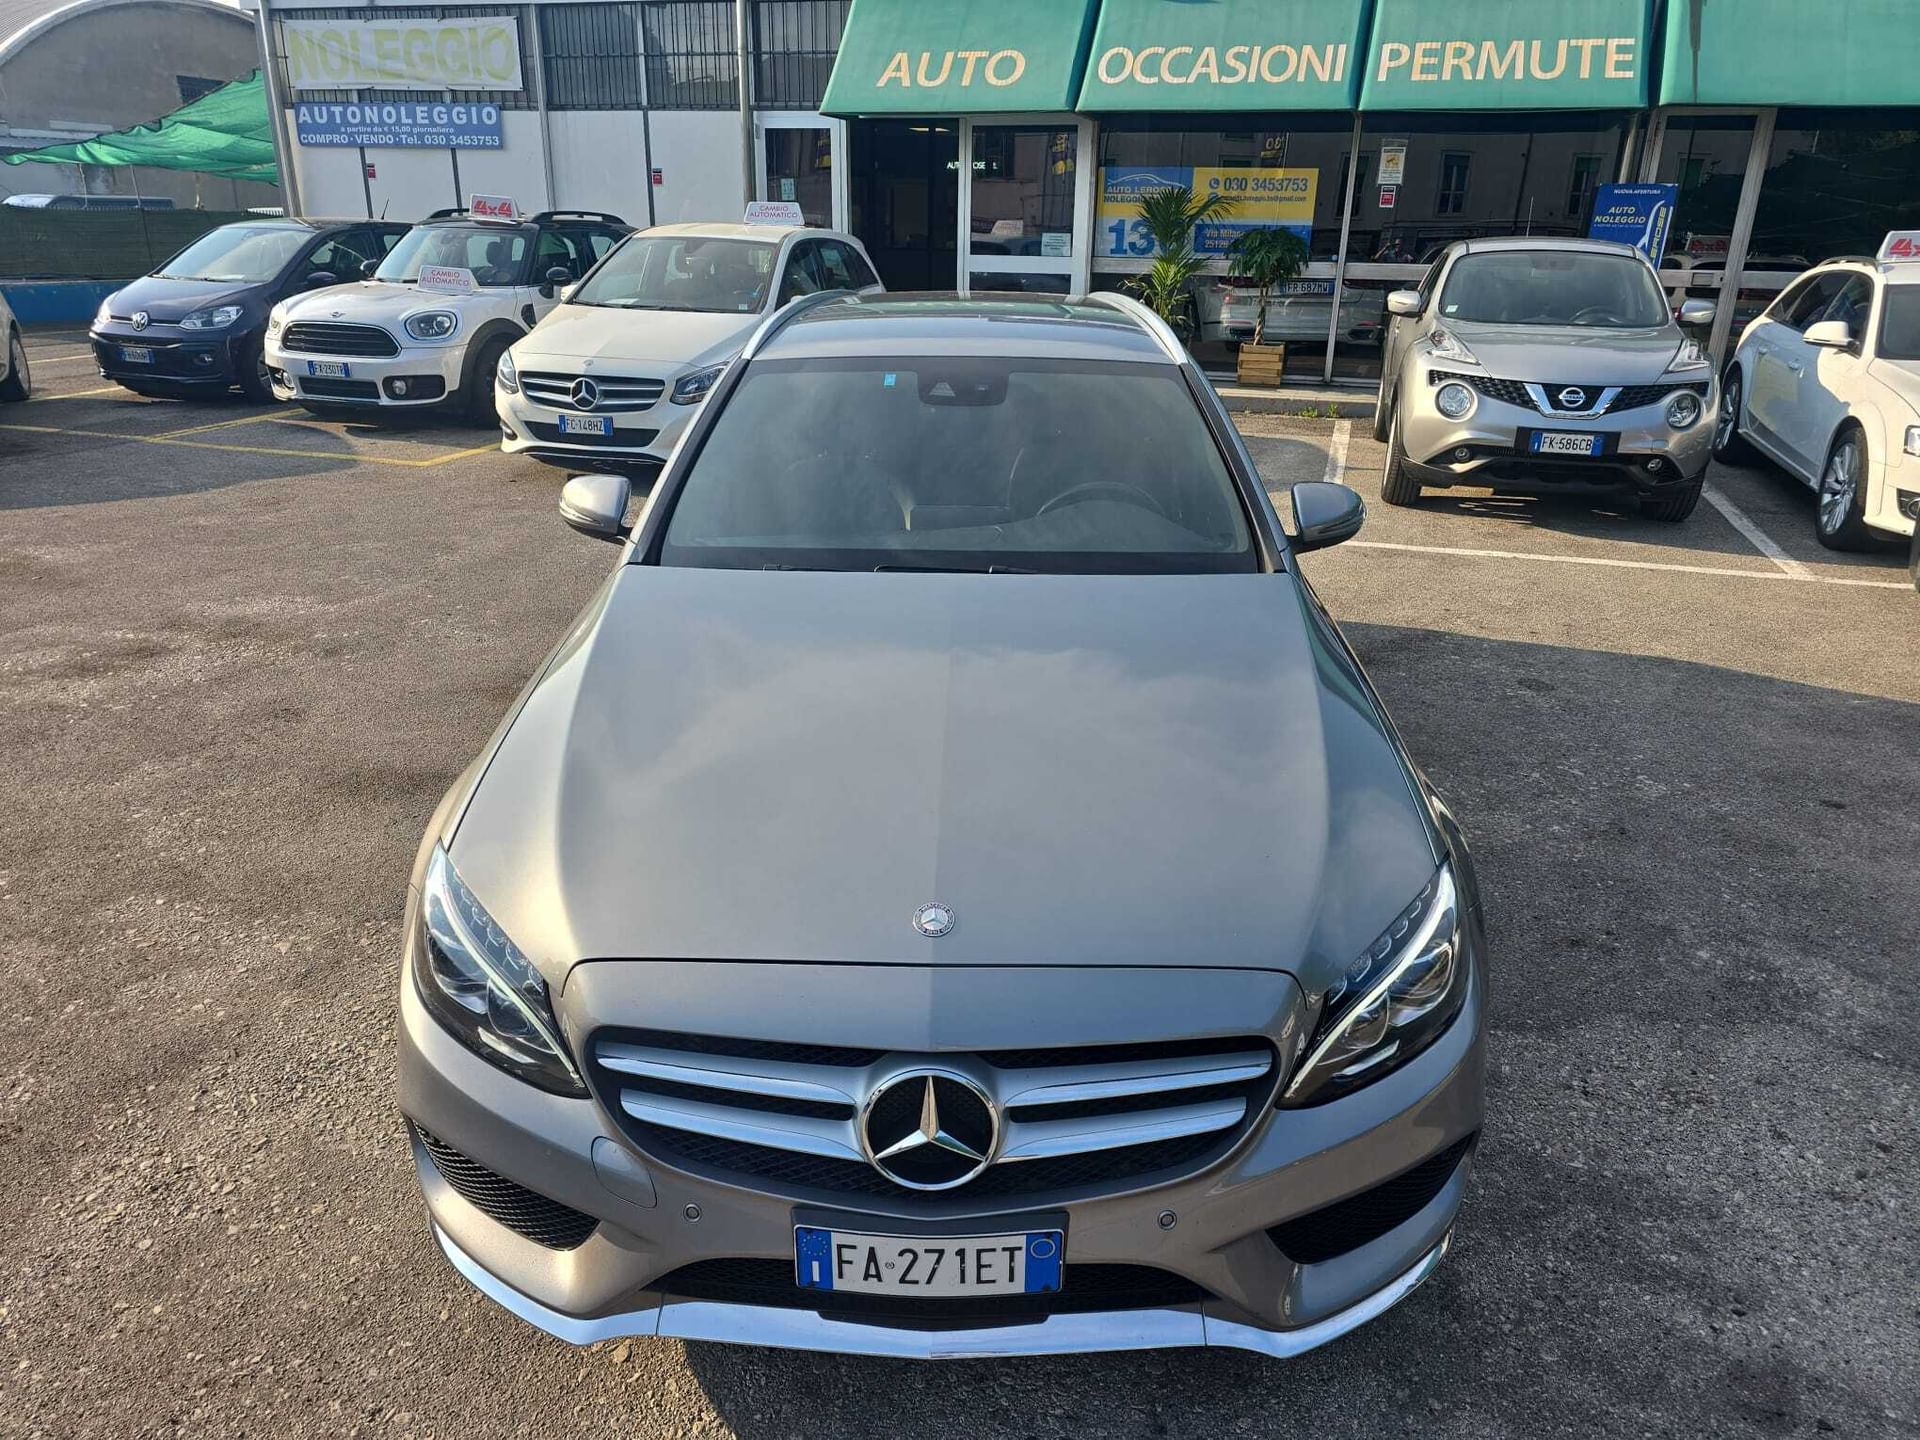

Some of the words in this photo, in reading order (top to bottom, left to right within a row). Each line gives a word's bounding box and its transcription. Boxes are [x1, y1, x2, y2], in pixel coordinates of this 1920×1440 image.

[287, 26, 518, 82] NOLEGGIO
[1377, 37, 1636, 82] PERMUTE
[876, 49, 1027, 88] AUTO
[1098, 44, 1349, 86] OCCASIONI
[298, 105, 498, 125] AUTONOLEGGIO
[412, 126, 455, 134] giornaliero
[300, 133, 349, 144] COMPRO
[354, 134, 395, 144] VENDO
[400, 134, 422, 145] Tel.
[424, 134, 446, 145] 030
[449, 135, 500, 145] 3453753
[1106, 186, 1132, 194] AUTO
[1223, 177, 1248, 192] 030
[1251, 177, 1309, 192] 3453753
[750, 211, 798, 219] AUTOMATICO
[1608, 206, 1636, 214] AUTO
[1594, 215, 1647, 224] NOLEGGIO
[431, 269, 460, 279] CAMBIO
[422, 277, 470, 287] AUTOMATICO
